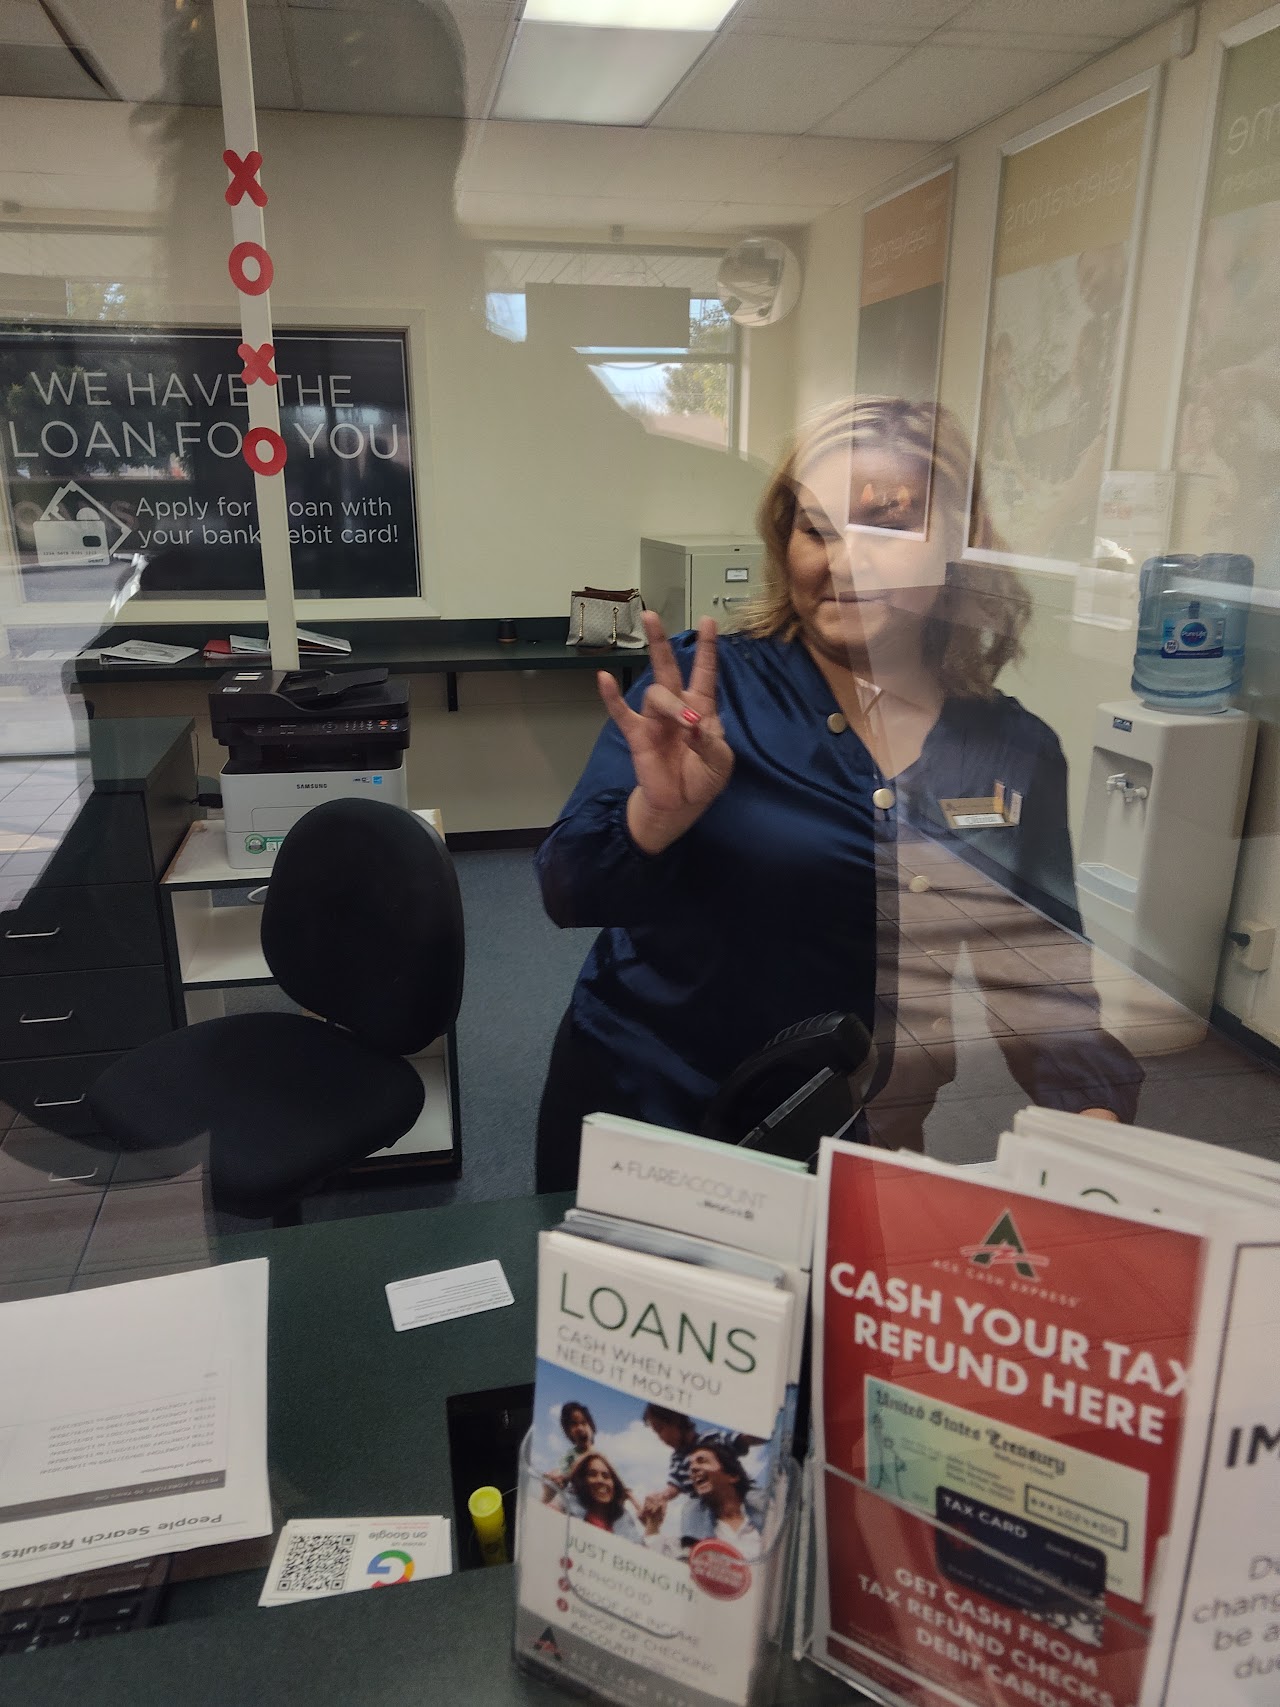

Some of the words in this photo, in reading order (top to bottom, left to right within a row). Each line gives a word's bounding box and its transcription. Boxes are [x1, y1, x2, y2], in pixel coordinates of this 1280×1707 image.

[30, 371, 112, 406] WE
[127, 373, 249, 407] HAVE
[276, 374, 354, 407] THE
[8, 420, 157, 458] LOAN
[176, 421, 252, 459] FO
[293, 423, 399, 460] YOU
[136, 496, 208, 520] Apply
[217, 496, 252, 517] for
[288, 501, 333, 517] oan
[341, 497, 392, 517] with
[138, 529, 194, 549] your
[202, 524, 262, 545] bank
[288, 525, 333, 544] ebit
[341, 524, 399, 544] card!
[965, 1266, 1005, 1286] CASH
[561, 1272, 757, 1374] LOANS
[830, 1262, 942, 1325] CASH
[955, 1296, 1089, 1371] YOUR
[1103, 1341, 1187, 1397] TAX
[557, 1325, 606, 1355] CASH
[613, 1344, 672, 1379] WHEN
[680, 1369, 722, 1395] YOU
[557, 1344, 604, 1375] NEED
[610, 1367, 624, 1381] IT
[633, 1374, 692, 1408] MOST!
[854, 1312, 1028, 1396] REFUND
[1042, 1372, 1166, 1445] HERE
[930, 1409, 981, 1441] States
[986, 1428, 1066, 1475] Treasury
[82, 1525, 151, 1545] Search
[158, 1513, 223, 1530] People
[369, 1529, 410, 1541] Google
[944, 1496, 975, 1518] TAX
[979, 1510, 1028, 1539] CARD
[0, 1539, 74, 1560] Results
[567, 1536, 606, 1561] JUST
[613, 1555, 670, 1592] BRING
[858, 1573, 901, 1608] TAX
[907, 1598, 1005, 1658] REFUND
[894, 1567, 938, 1600] GET
[944, 1590, 1013, 1635] CASH
[1018, 1624, 1099, 1677] FROM
[916, 1627, 984, 1671] DEBIT
